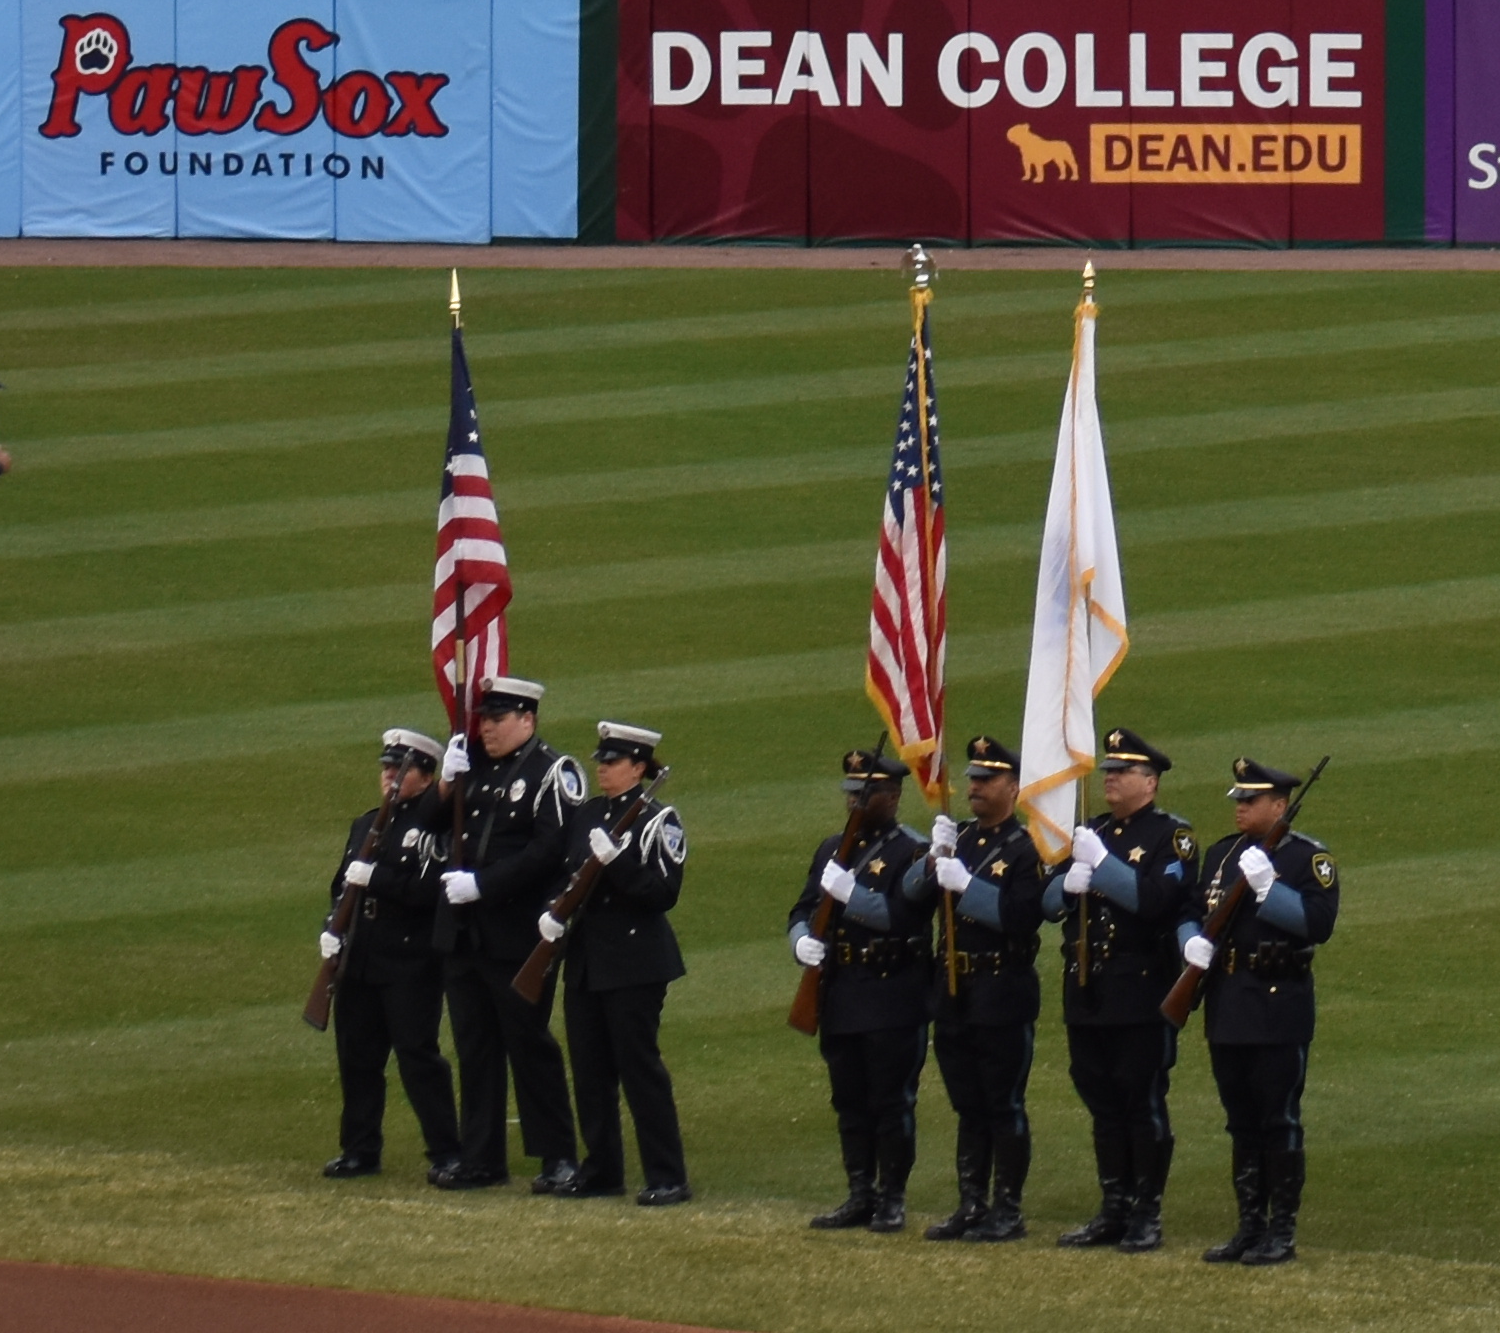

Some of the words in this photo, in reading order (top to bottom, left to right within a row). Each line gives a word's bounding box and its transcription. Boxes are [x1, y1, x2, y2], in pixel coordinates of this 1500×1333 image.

[38, 12, 451, 139] PawSox
[652, 31, 903, 107] DEAN
[937, 32, 1363, 108] COLLEGE
[100, 150, 384, 179] FOUNDATION
[1103, 136, 1348, 172] DEAN.EDU
